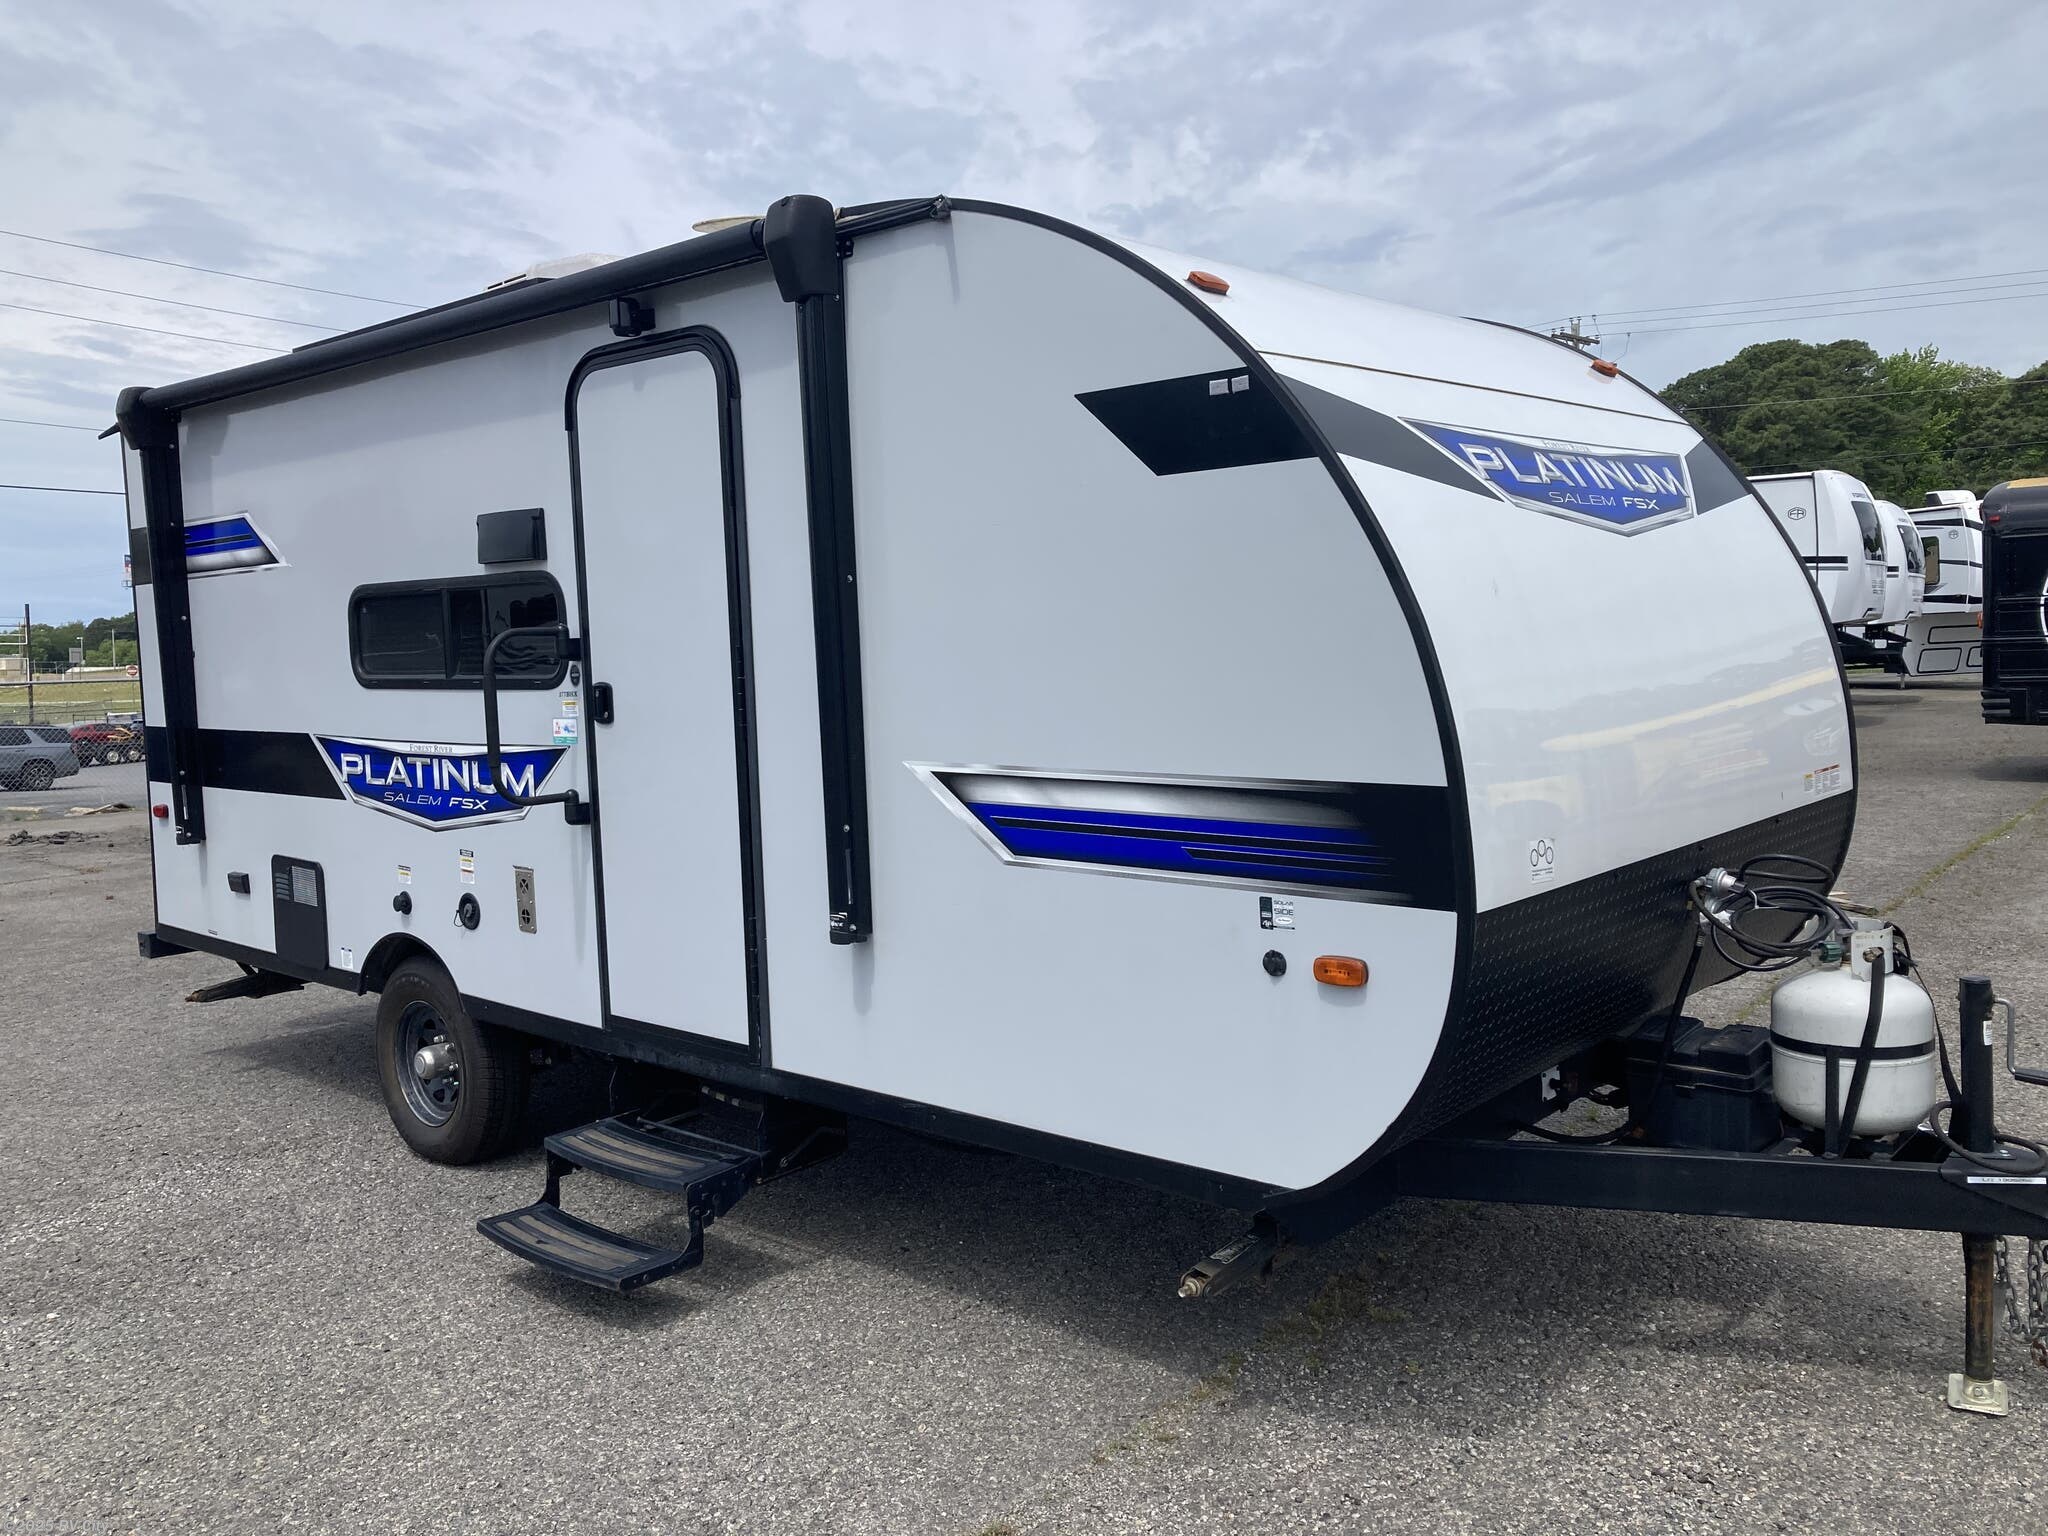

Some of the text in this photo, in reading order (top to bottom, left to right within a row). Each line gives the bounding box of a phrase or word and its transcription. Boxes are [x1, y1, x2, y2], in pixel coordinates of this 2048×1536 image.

[1458, 442, 1692, 497] PLATINUM
[1549, 491, 1660, 511] SALEM FSX
[409, 743, 432, 752] FOREST
[341, 753, 535, 797] PLATINUM
[384, 791, 488, 810] SALEM FSX
[1274, 908, 1294, 916] SIDE
